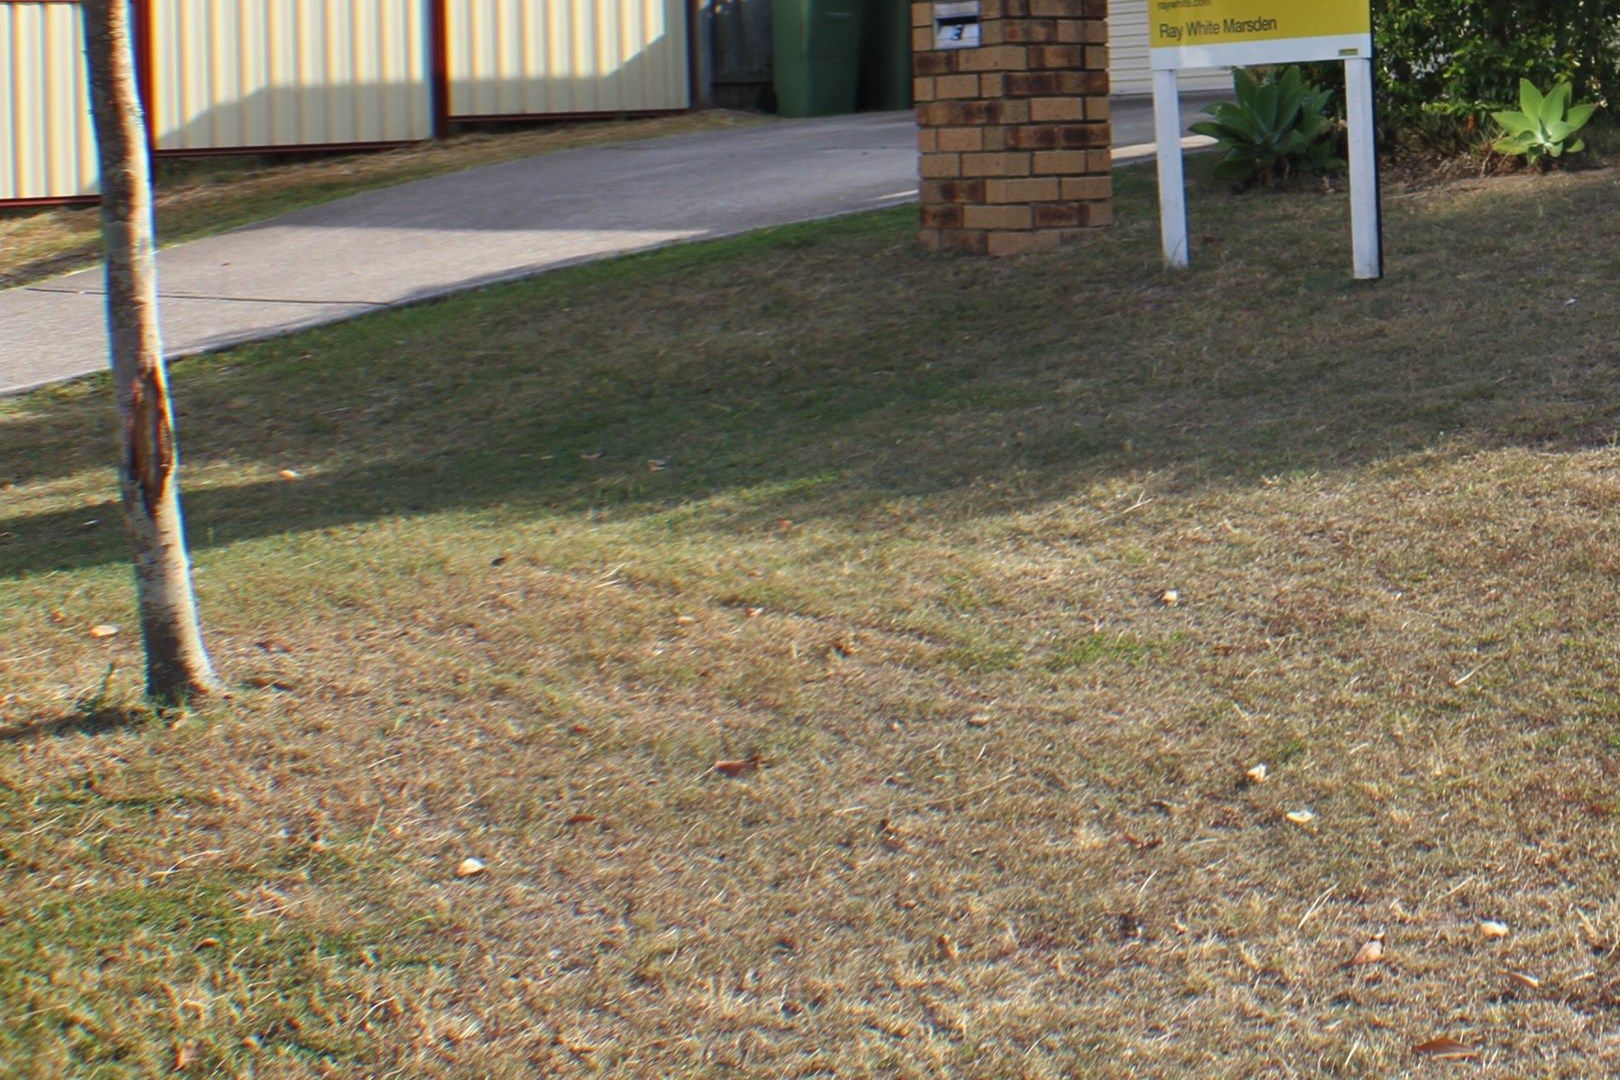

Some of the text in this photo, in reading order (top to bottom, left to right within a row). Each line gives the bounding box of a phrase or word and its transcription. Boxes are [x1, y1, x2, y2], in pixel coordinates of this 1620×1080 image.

[1159, 16, 1277, 41] Ray White Marsden
